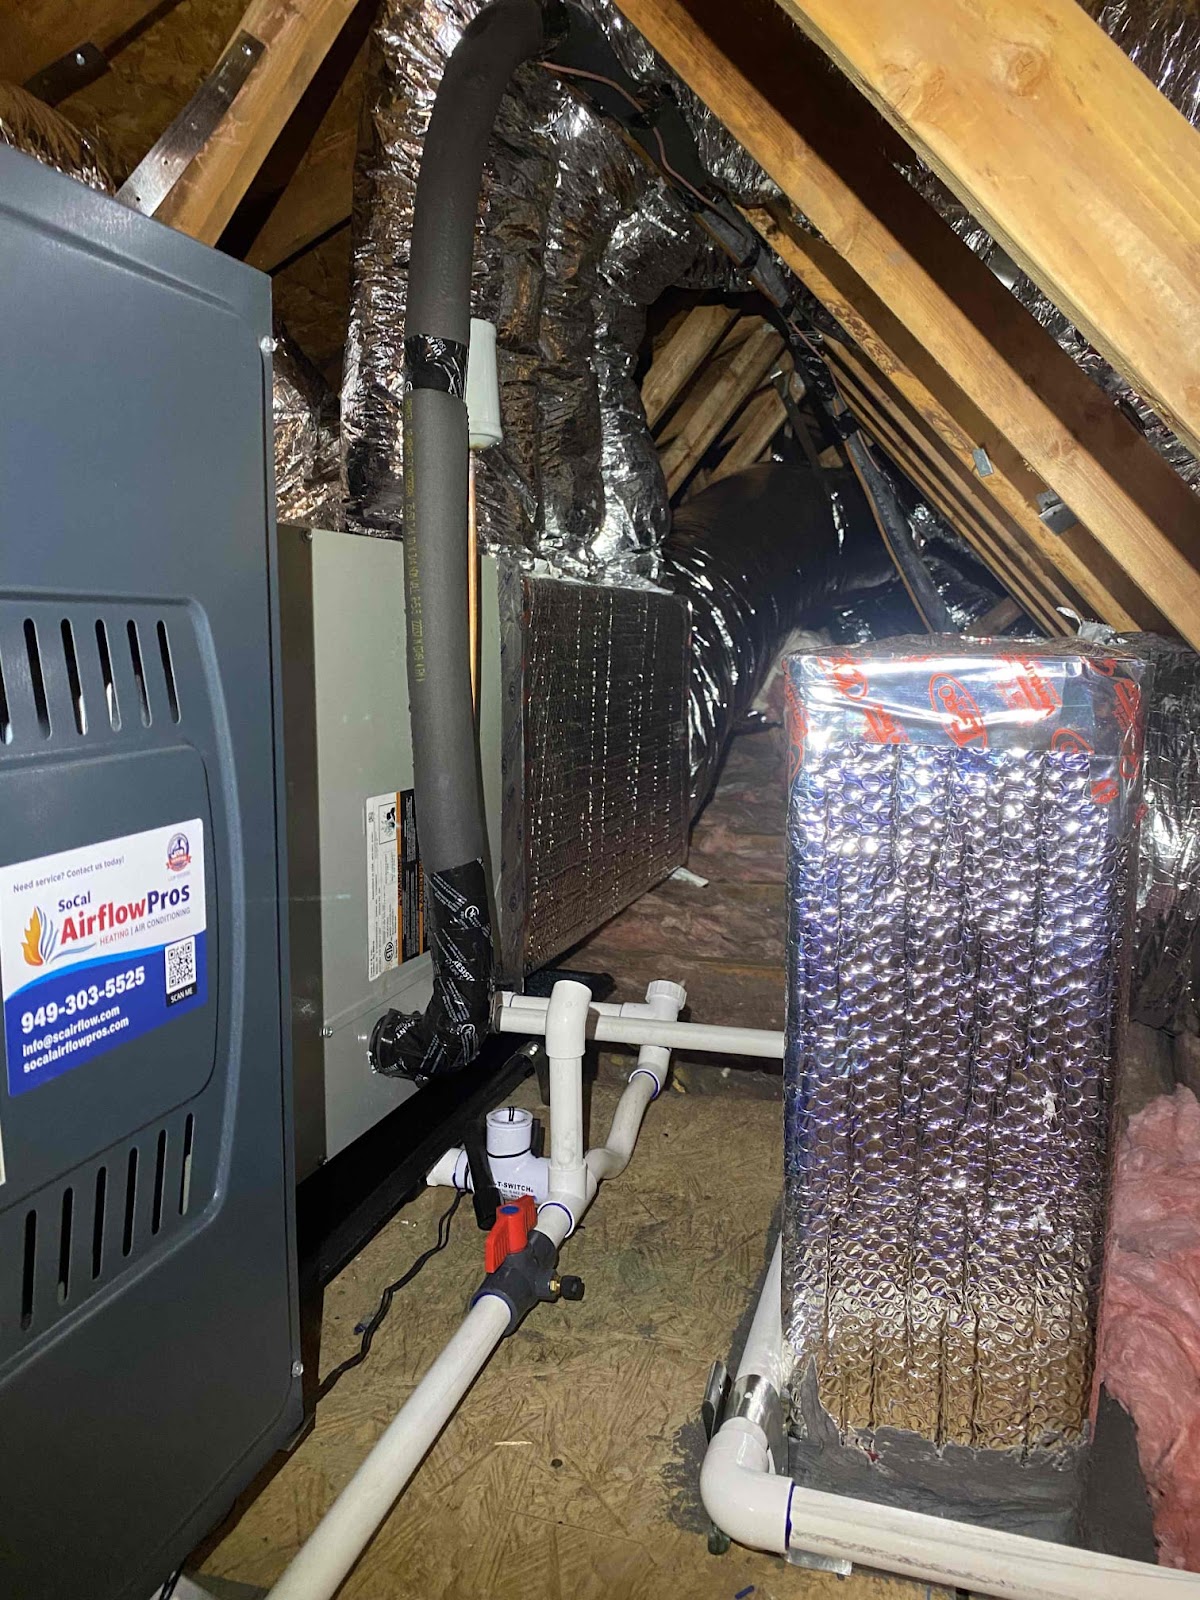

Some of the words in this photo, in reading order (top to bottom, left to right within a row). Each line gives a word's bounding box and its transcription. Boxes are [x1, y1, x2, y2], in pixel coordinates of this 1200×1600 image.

[13, 880, 33, 893] Need
[36, 872, 65, 887] service?
[67, 865, 94, 878] Contact
[95, 862, 103, 870] us
[104, 856, 125, 869] today!
[58, 890, 91, 913] SoCal
[60, 885, 190, 945] AirflowPros
[100, 929, 129, 946] HEATING
[134, 922, 145, 933] AIR
[147, 907, 191, 928] CONDITIONING
[21, 965, 145, 1034] 949-303-5525
[170, 991, 184, 1004] SCAN
[185, 987, 193, 996] ME
[22, 1006, 120, 1057] info@scairflow.com
[23, 1017, 129, 1073] socalairflowpros.com
